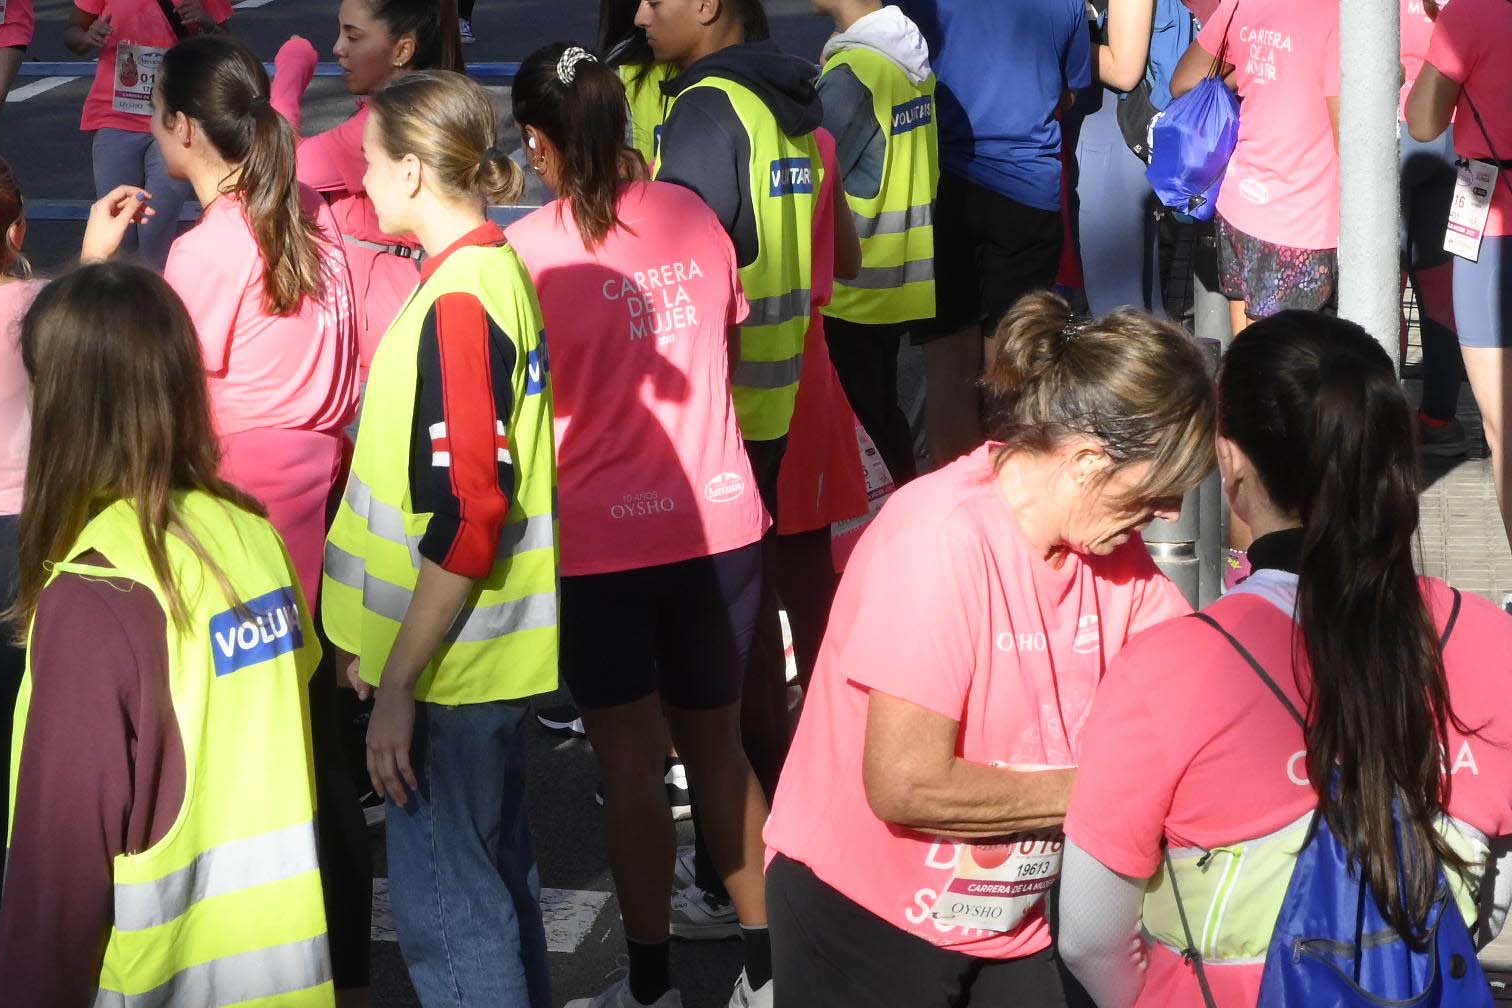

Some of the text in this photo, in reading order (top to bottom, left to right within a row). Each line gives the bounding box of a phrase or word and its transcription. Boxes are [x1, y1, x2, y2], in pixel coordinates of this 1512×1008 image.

[140, 73, 156, 83] 01
[602, 258, 703, 301] CARRERA
[627, 284, 691, 318] DE LA
[630, 305, 698, 341] MUJER
[611, 497, 674, 519] OYSHO
[1016, 860, 1050, 877] 19613
[968, 881, 1011, 895] CARRERA
[951, 902, 1003, 918] OYSHO
